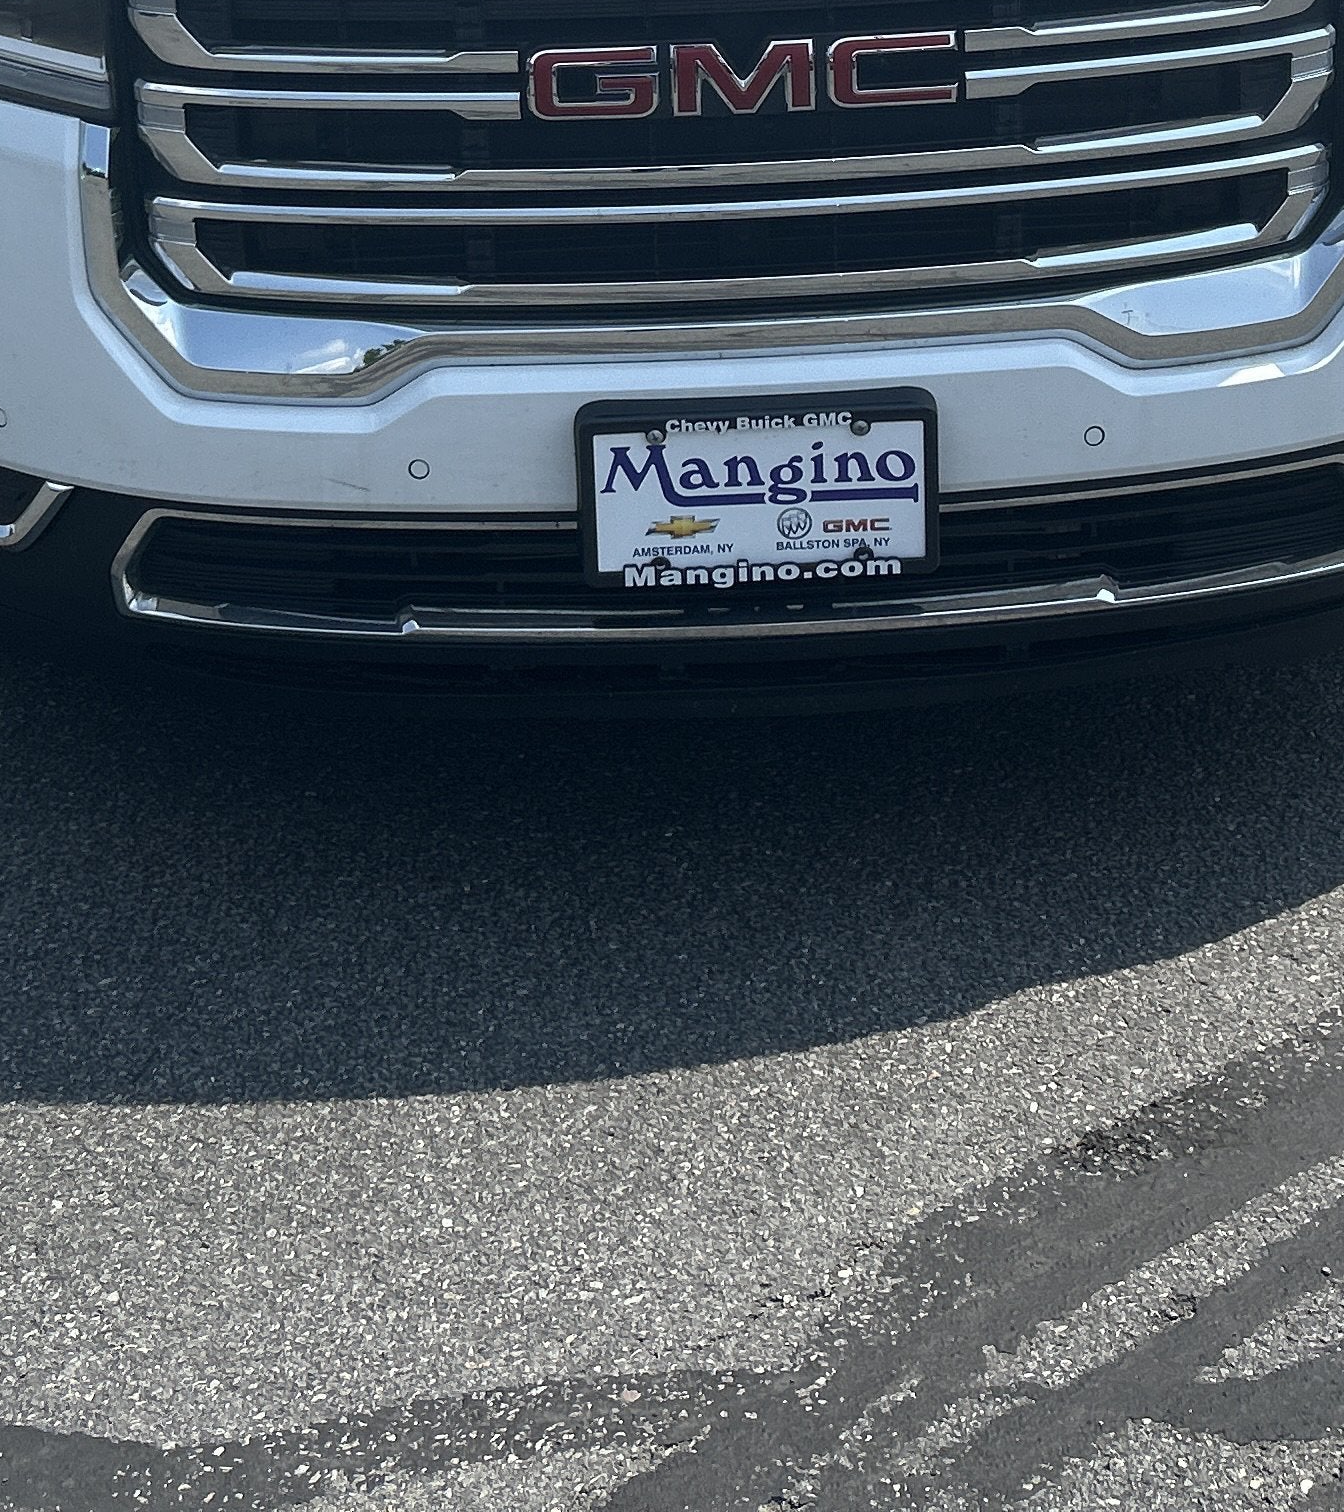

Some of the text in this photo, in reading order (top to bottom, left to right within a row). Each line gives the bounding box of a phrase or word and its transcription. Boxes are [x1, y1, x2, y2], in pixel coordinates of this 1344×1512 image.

[527, 31, 959, 121] GMC
[665, 411, 852, 434] Chevy Buick GMC
[600, 441, 919, 507] Mangino
[822, 517, 892, 533] GMC
[632, 543, 734, 558] AMSTERDAM, NY
[776, 537, 890, 551] BALLSTON SPA, NY
[623, 558, 902, 588] Mangino.com
